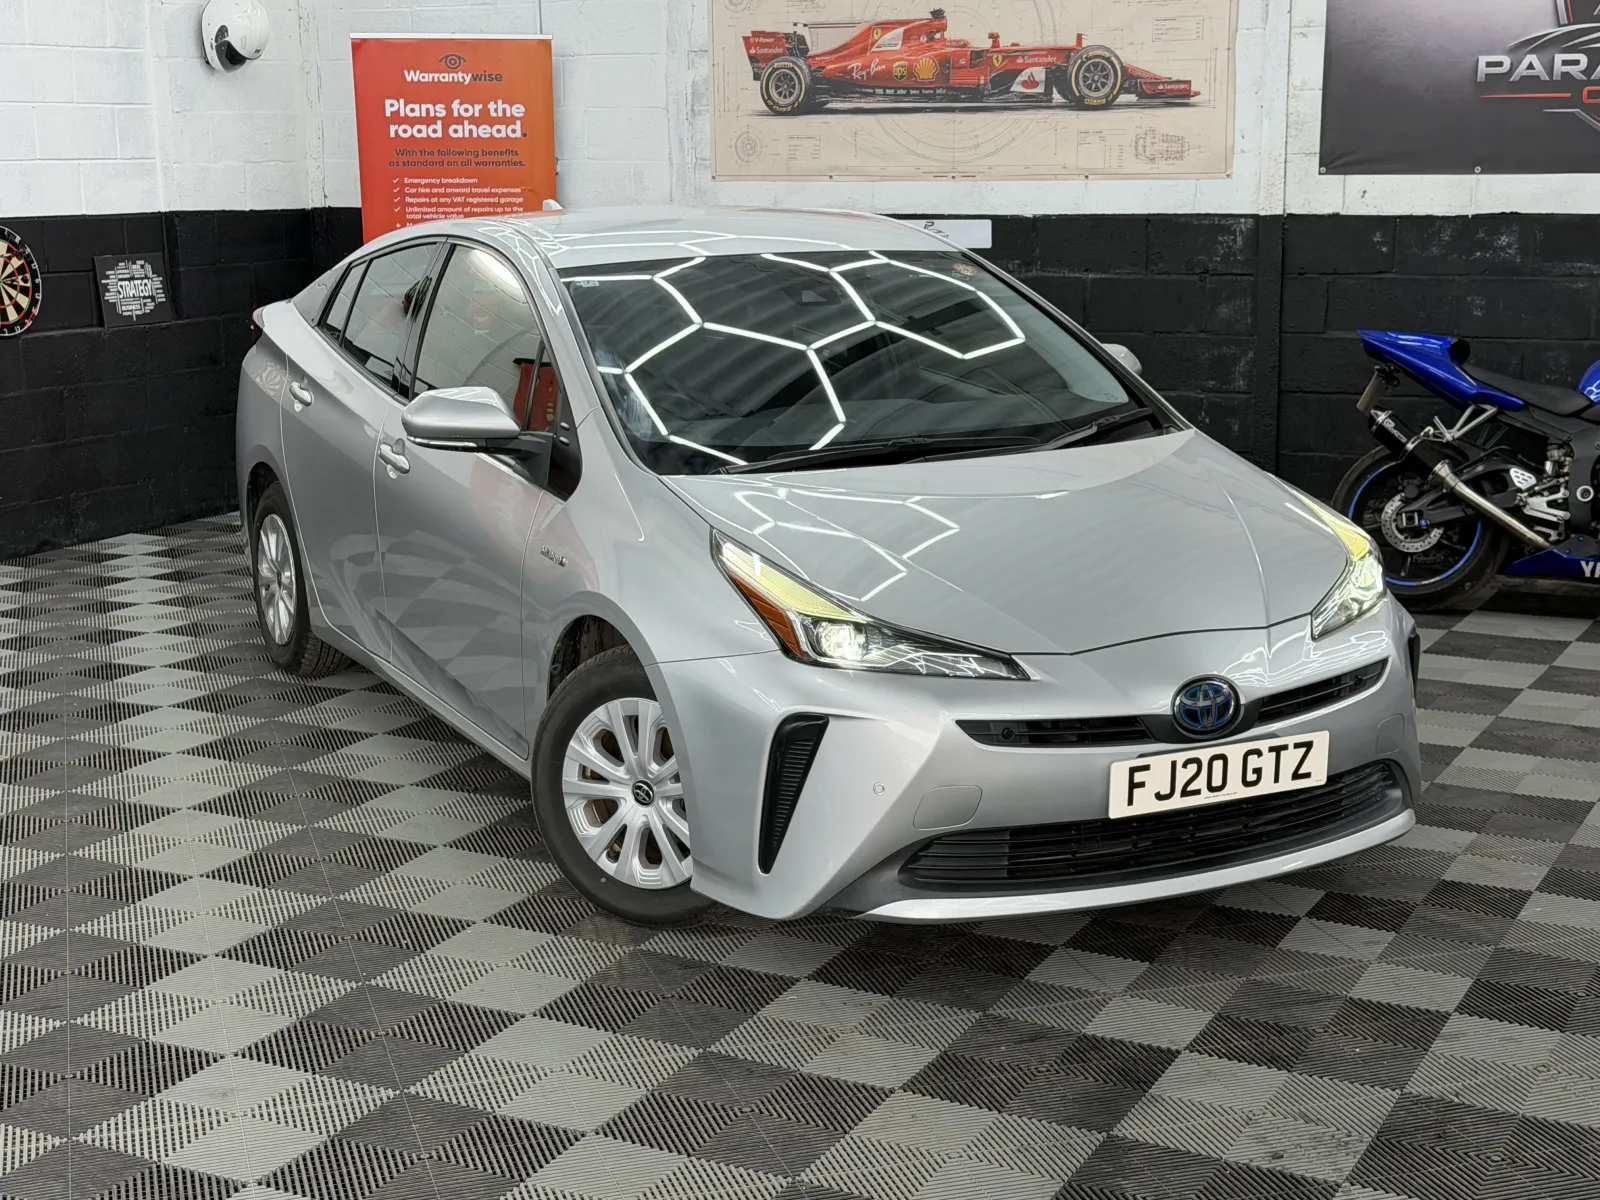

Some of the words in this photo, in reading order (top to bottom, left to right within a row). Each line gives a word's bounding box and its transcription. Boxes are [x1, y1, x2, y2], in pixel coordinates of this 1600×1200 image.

[1024, 55, 1057, 64] Santander
[1476, 54, 1600, 82] PAR
[404, 70, 503, 85] Warrantywise
[848, 58, 886, 80] Ray-Ban
[384, 98, 446, 118] Plans
[451, 99, 482, 117] for
[488, 99, 526, 117] the
[389, 120, 442, 138] road
[448, 120, 528, 138] ahead.
[395, 149, 418, 157] With
[420, 149, 434, 157] the
[437, 148, 479, 158] following
[482, 148, 518, 157] benefits
[402, 158, 444, 167] standard
[460, 158, 472, 167] all
[474, 158, 526, 167] warranties.
[118, 279, 152, 298] STRATEGY
[1126, 752, 1229, 807] FJ20
[1240, 740, 1314, 788] GTZ
